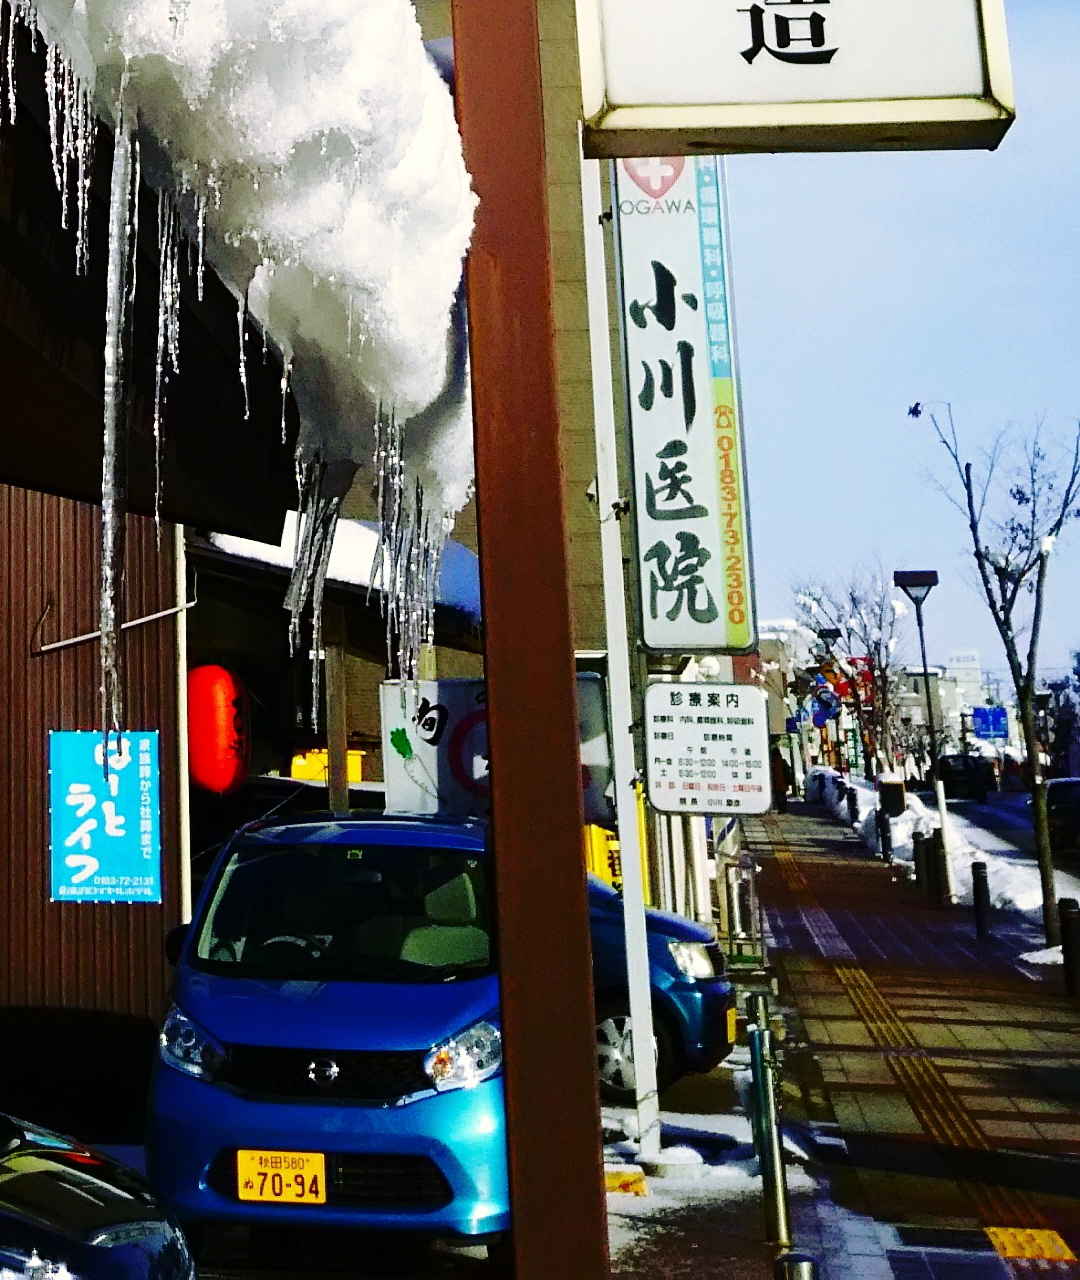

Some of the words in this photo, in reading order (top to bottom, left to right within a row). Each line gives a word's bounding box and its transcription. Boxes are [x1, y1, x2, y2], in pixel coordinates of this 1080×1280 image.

[620, 198, 696, 216] OGAWA
[629, 260, 719, 624] 小川医院
[717, 435, 746, 624] 0183-73-2300
[670, 691, 739, 708] 診療案内
[64, 783, 100, 884] ライフ
[257, 1172, 320, 1199] 70-94
